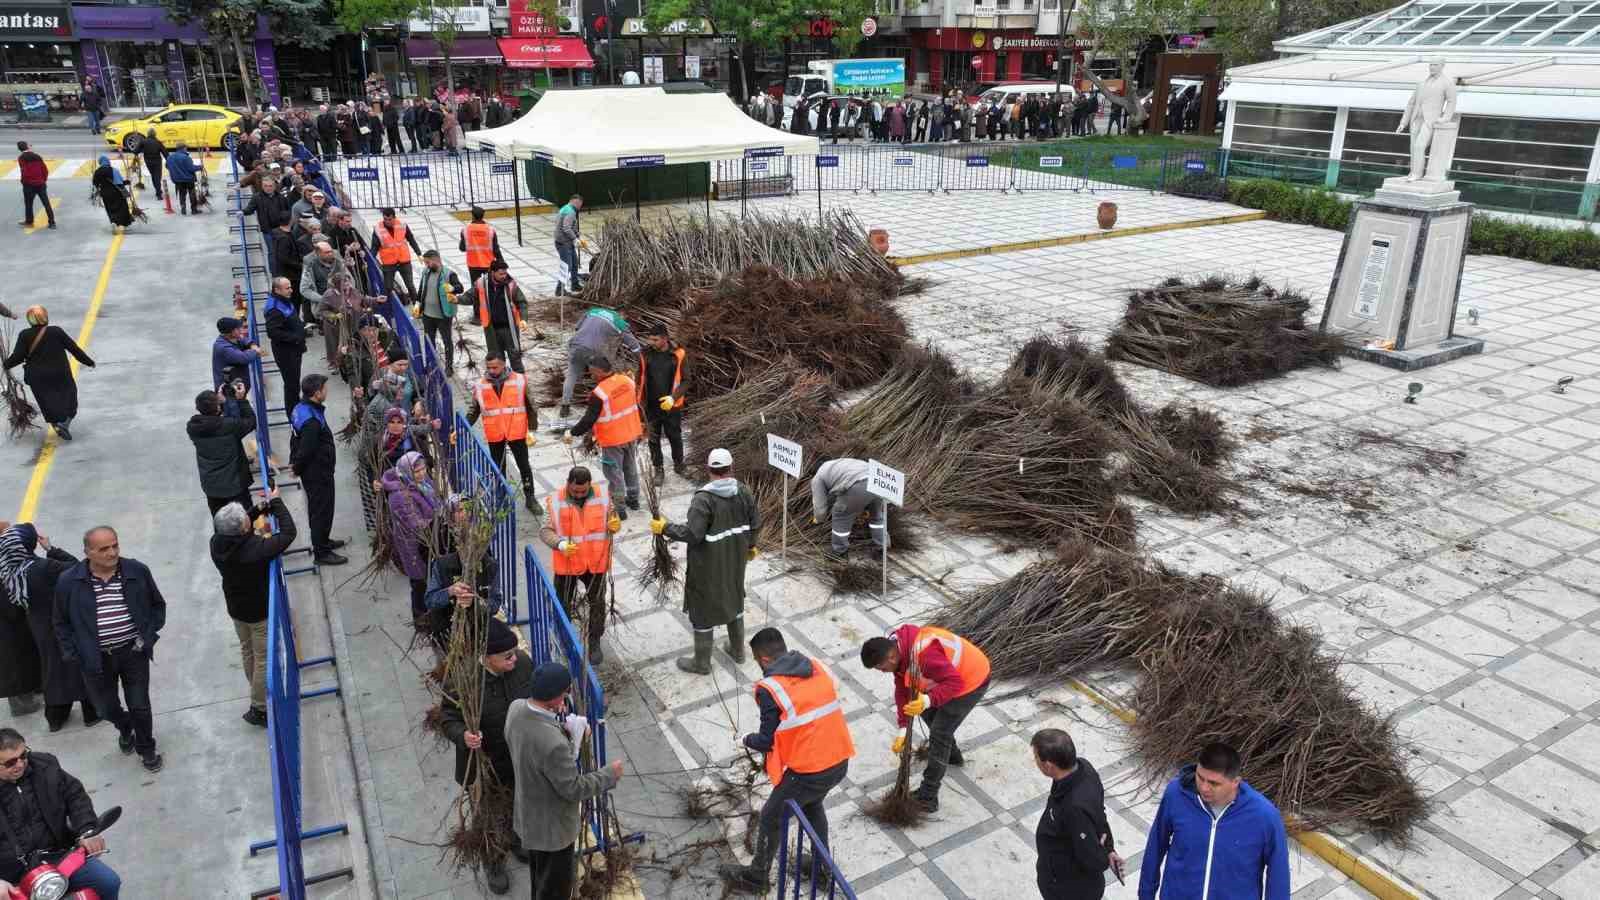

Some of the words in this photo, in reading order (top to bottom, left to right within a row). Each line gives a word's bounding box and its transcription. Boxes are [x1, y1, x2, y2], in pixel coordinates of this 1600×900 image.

[351, 171, 376, 179] ZABITA
[773, 443, 798, 456] ARMUT
[876, 468, 897, 482] ELMA
[873, 477, 899, 495] FİDANI
